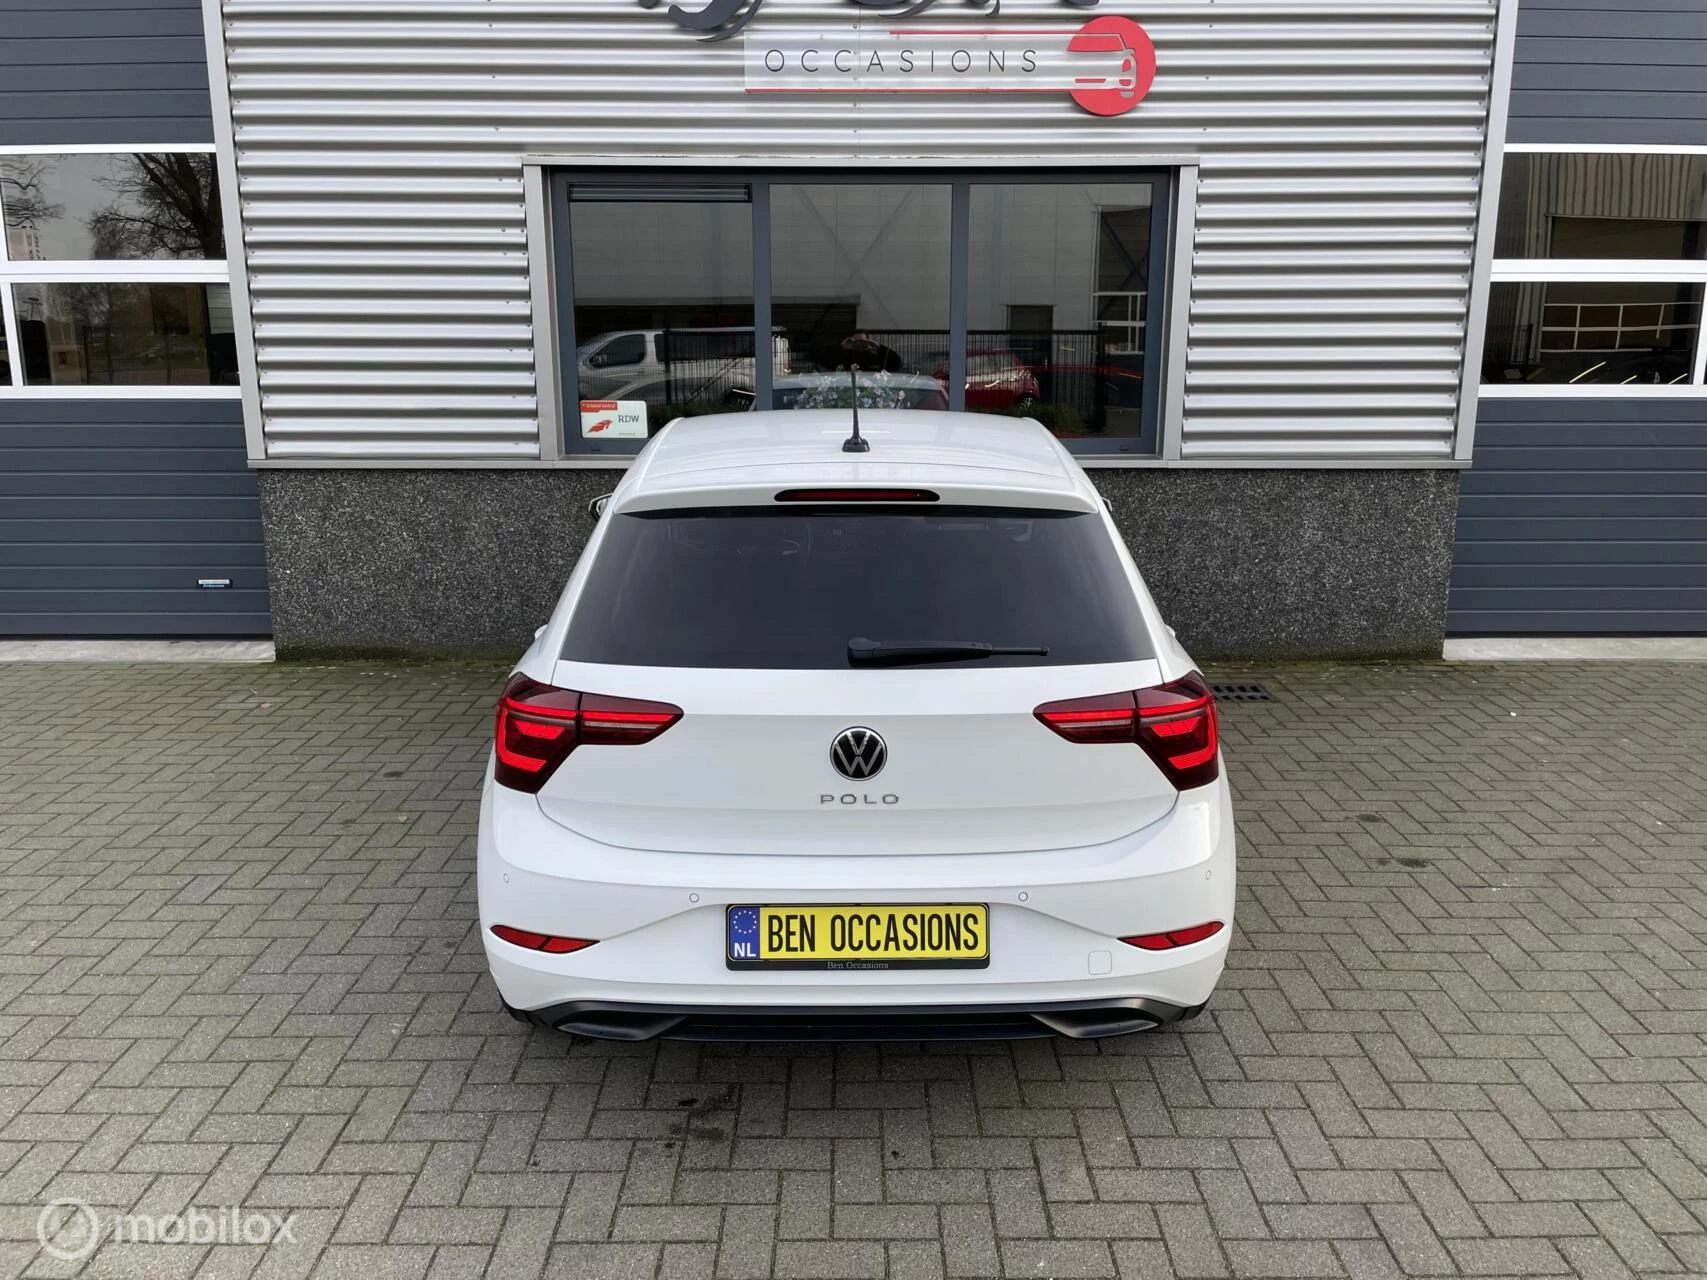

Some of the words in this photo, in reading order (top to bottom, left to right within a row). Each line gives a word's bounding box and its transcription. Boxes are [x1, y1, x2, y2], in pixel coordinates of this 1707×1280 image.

[764, 49, 1037, 73] OCCASIONS
[617, 415, 640, 423] RDW
[820, 794, 899, 804] POLO
[768, 914, 816, 952] BEN
[830, 913, 979, 952] OCCASIONS
[734, 943, 756, 957] NL
[827, 961, 844, 969] Ben
[846, 961, 889, 969] Occasions
